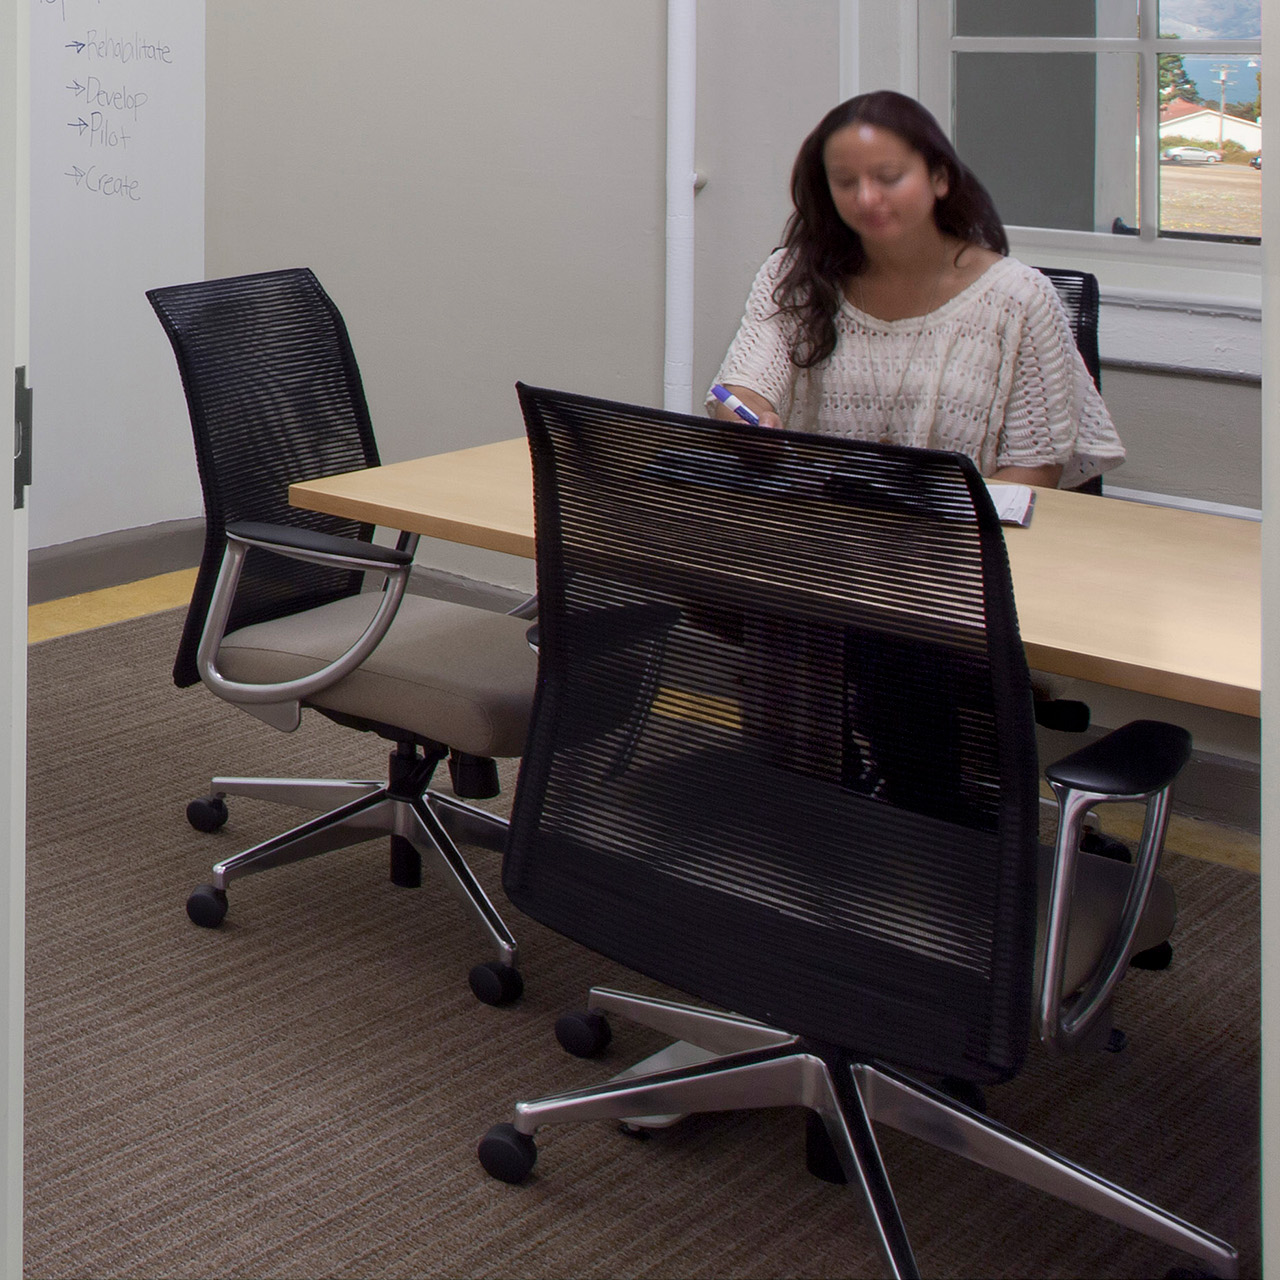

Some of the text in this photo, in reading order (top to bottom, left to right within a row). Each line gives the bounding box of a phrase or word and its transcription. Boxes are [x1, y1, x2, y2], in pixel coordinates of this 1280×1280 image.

[86, 26, 174, 65] Rehabilitate
[86, 76, 149, 122] Develop
[89, 110, 132, 150] Pilot
[85, 164, 142, 202] Create
